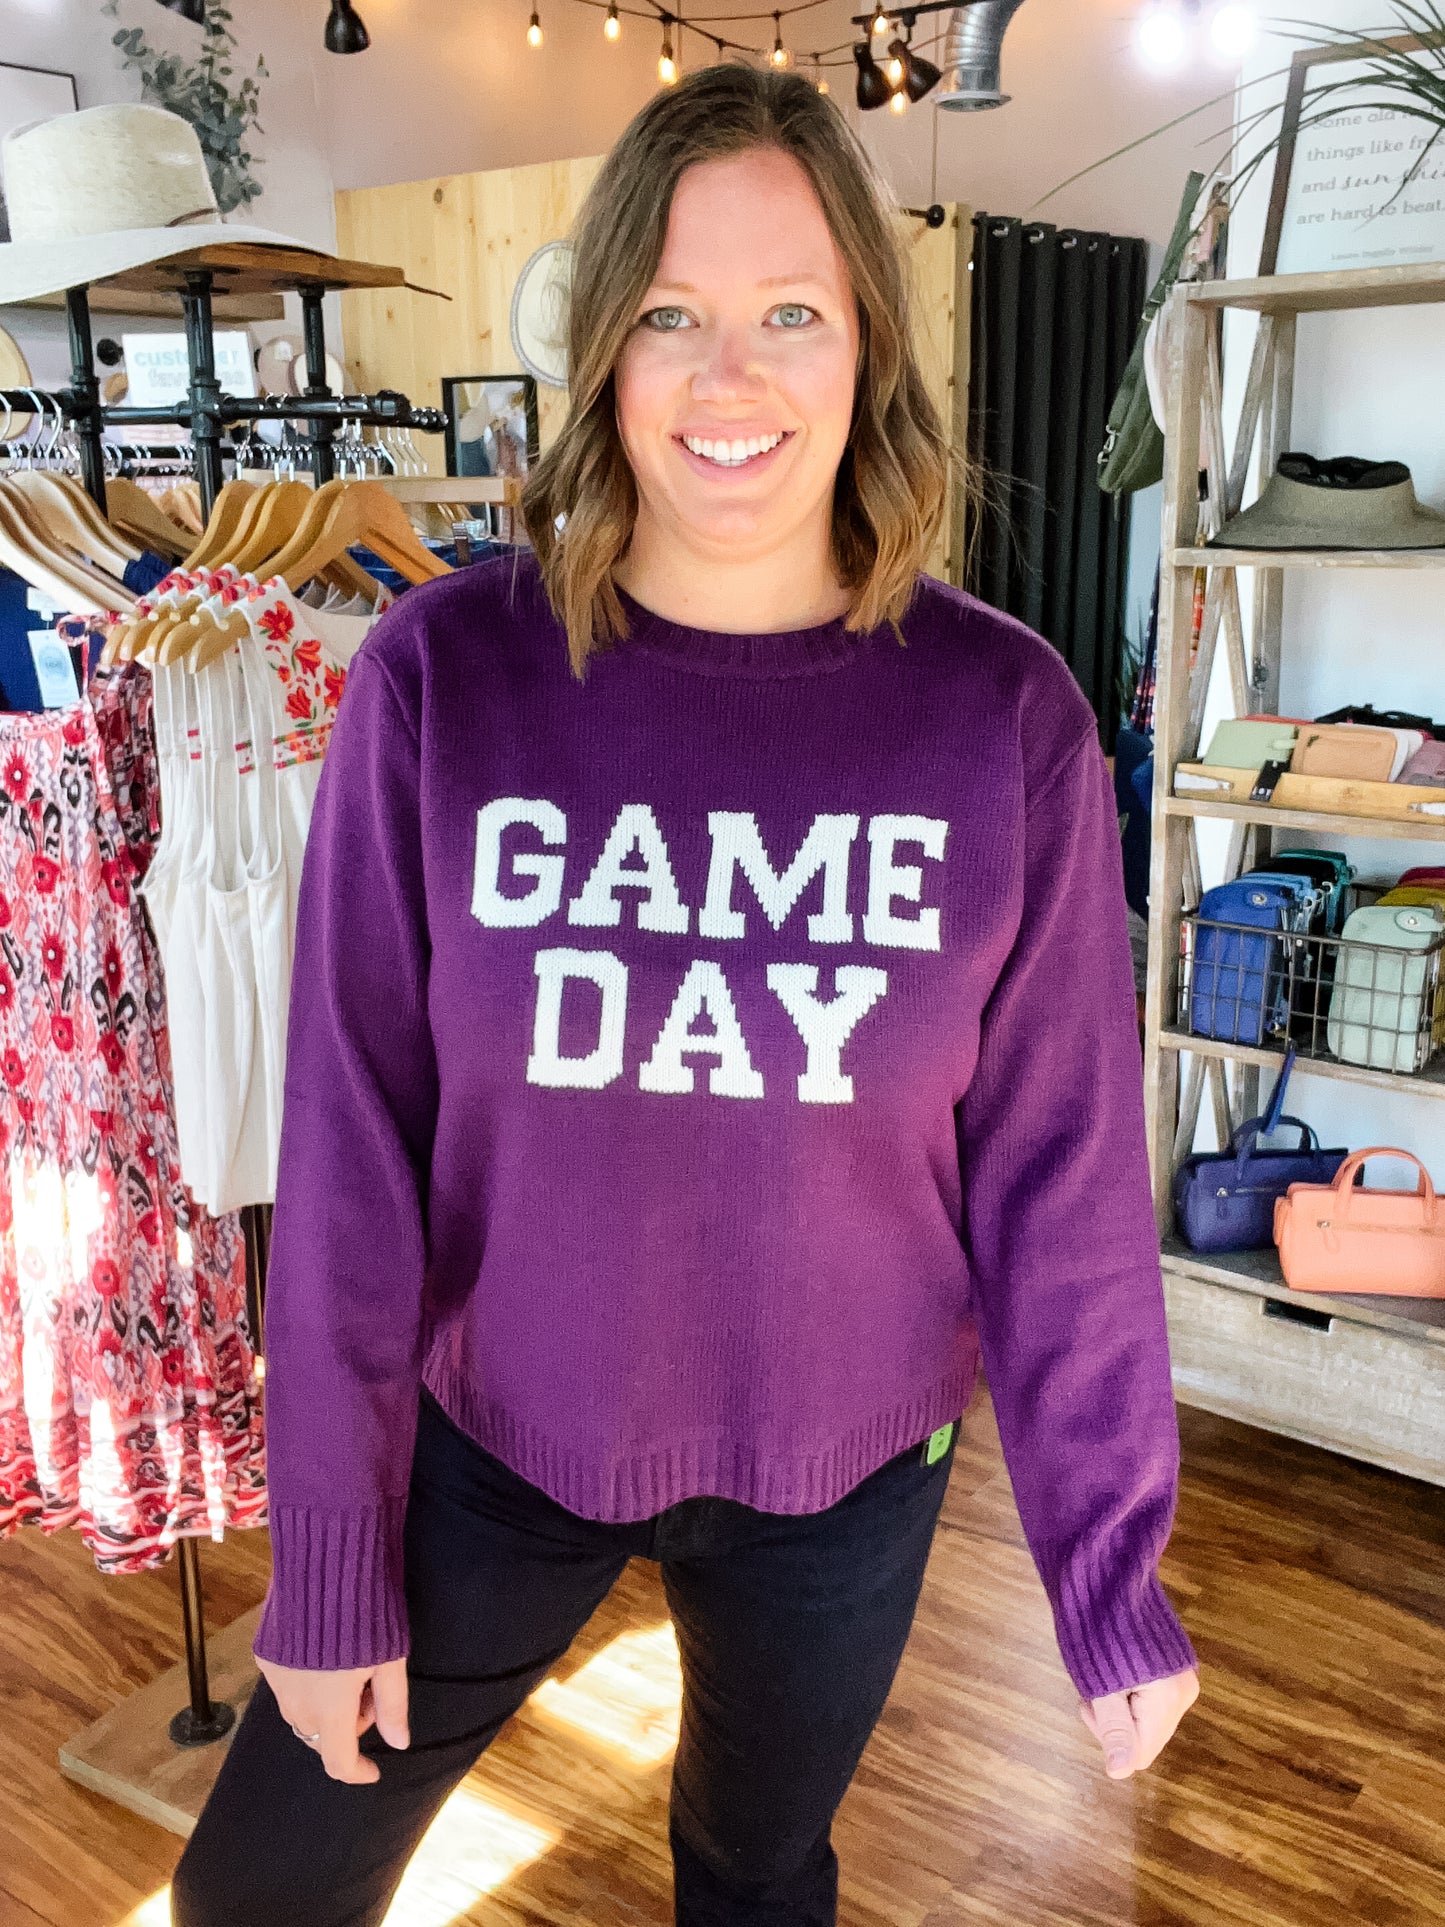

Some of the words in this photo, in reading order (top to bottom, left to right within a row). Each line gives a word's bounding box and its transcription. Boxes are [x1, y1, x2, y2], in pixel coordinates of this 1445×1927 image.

[1307, 144, 1364, 162] things
[1371, 139, 1403, 155] like
[1302, 174, 1336, 194] and
[1296, 211, 1325, 225] are
[1331, 204, 1374, 221] hard
[134, 348, 239, 367] custer
[470, 797, 949, 951] GAME
[526, 947, 888, 1104] DAY
